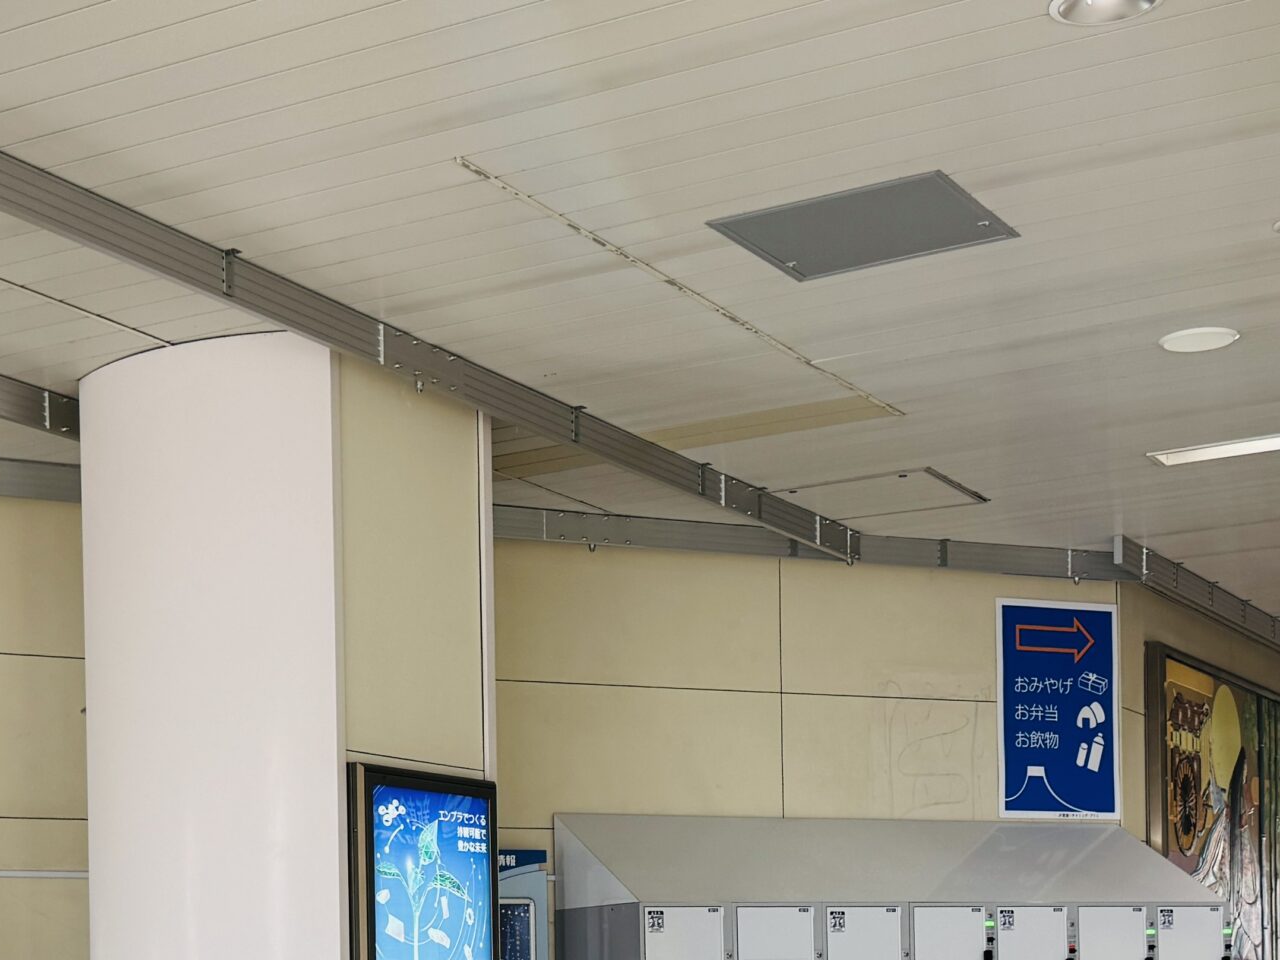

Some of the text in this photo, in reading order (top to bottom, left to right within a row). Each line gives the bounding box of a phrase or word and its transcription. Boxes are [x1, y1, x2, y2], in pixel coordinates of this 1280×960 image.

[1014, 676, 1073, 694] おみやげ
[1014, 703, 1058, 722] お弁当
[1015, 731, 1059, 749] お飲物
[438, 810, 486, 826] エンプラでつくる
[457, 826, 487, 840] 持続可能で
[457, 840, 488, 854] 豊かな未来
